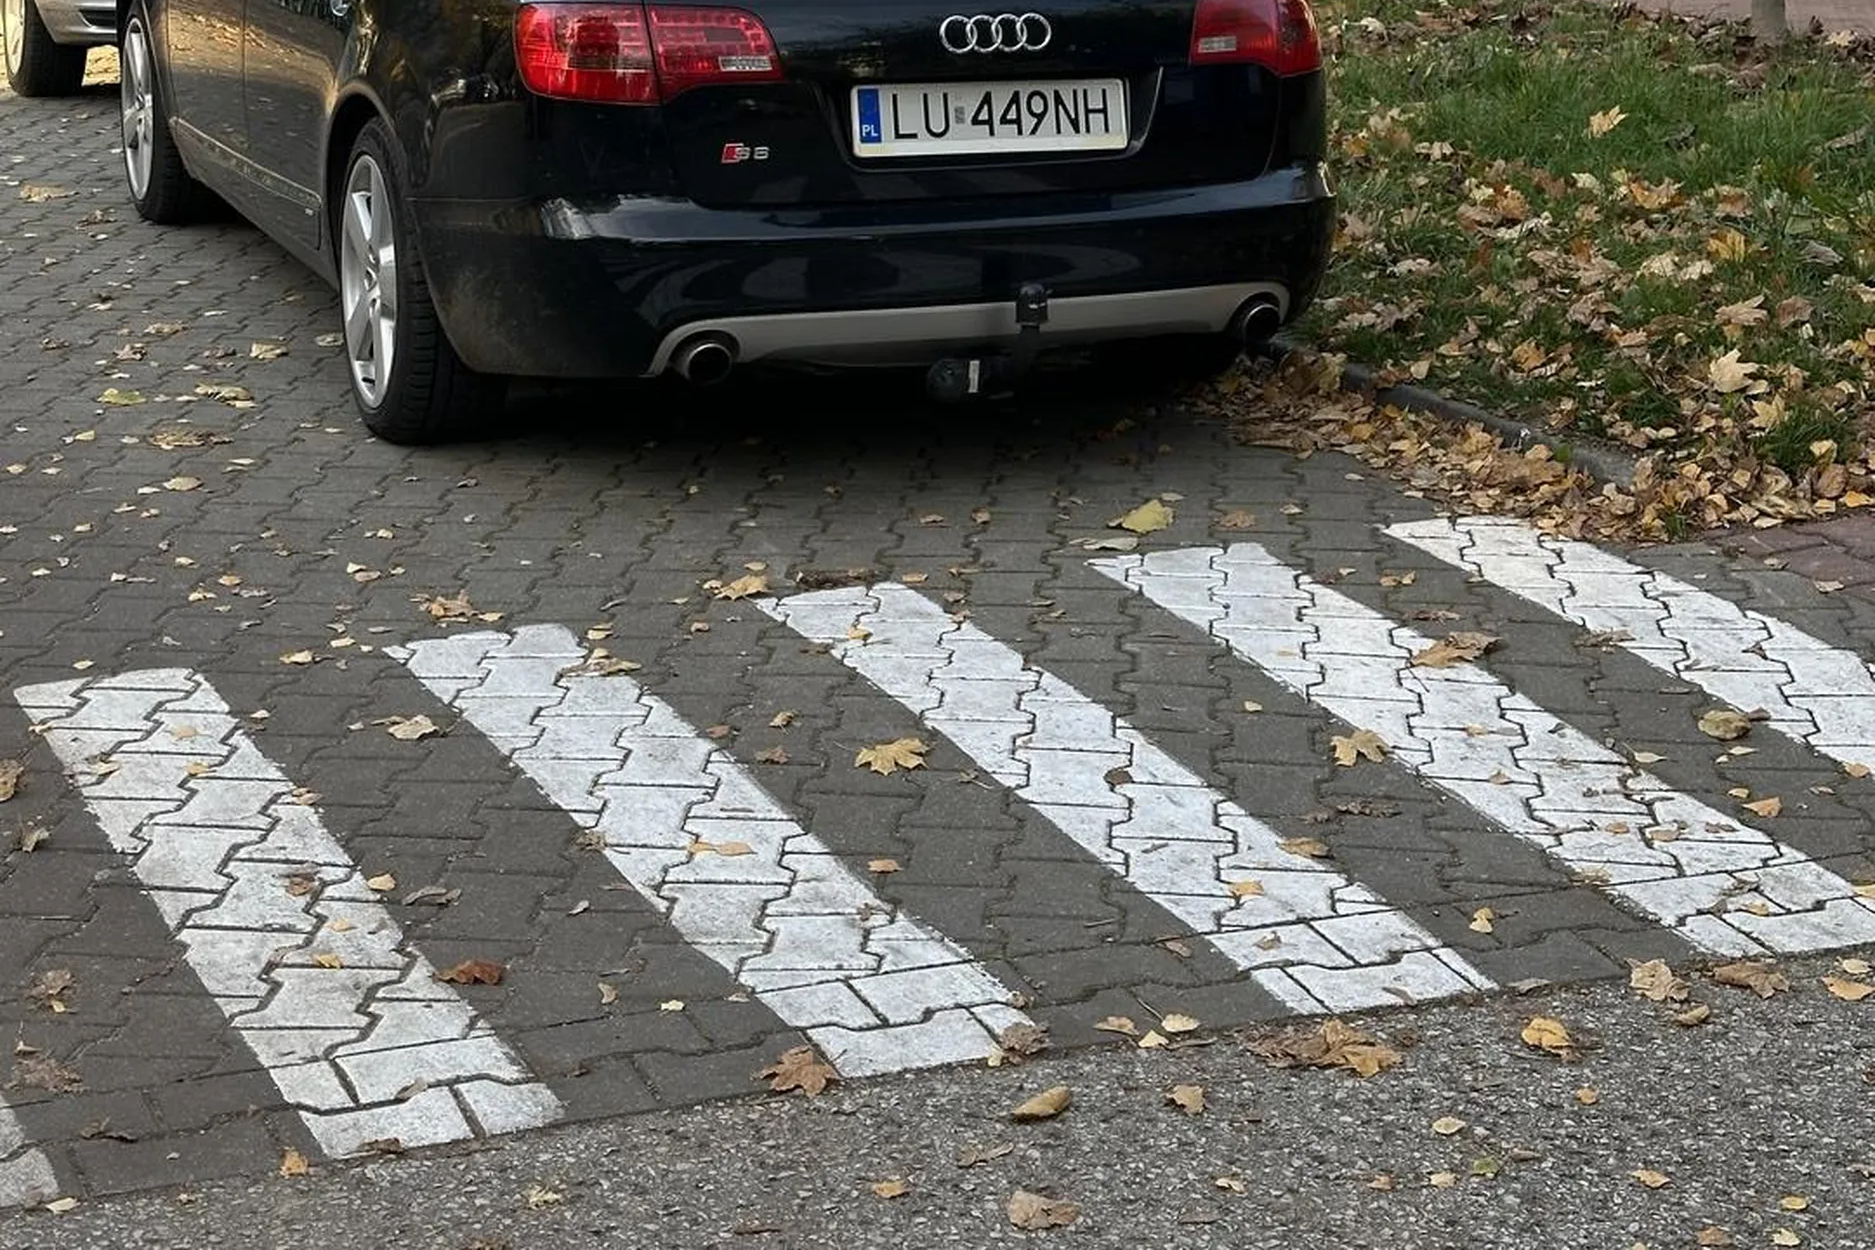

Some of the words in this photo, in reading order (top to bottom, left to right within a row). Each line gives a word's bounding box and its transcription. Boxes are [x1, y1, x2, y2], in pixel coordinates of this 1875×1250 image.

[891, 92, 951, 140] LU
[970, 88, 1111, 137] 449NH
[862, 124, 879, 137] PL
